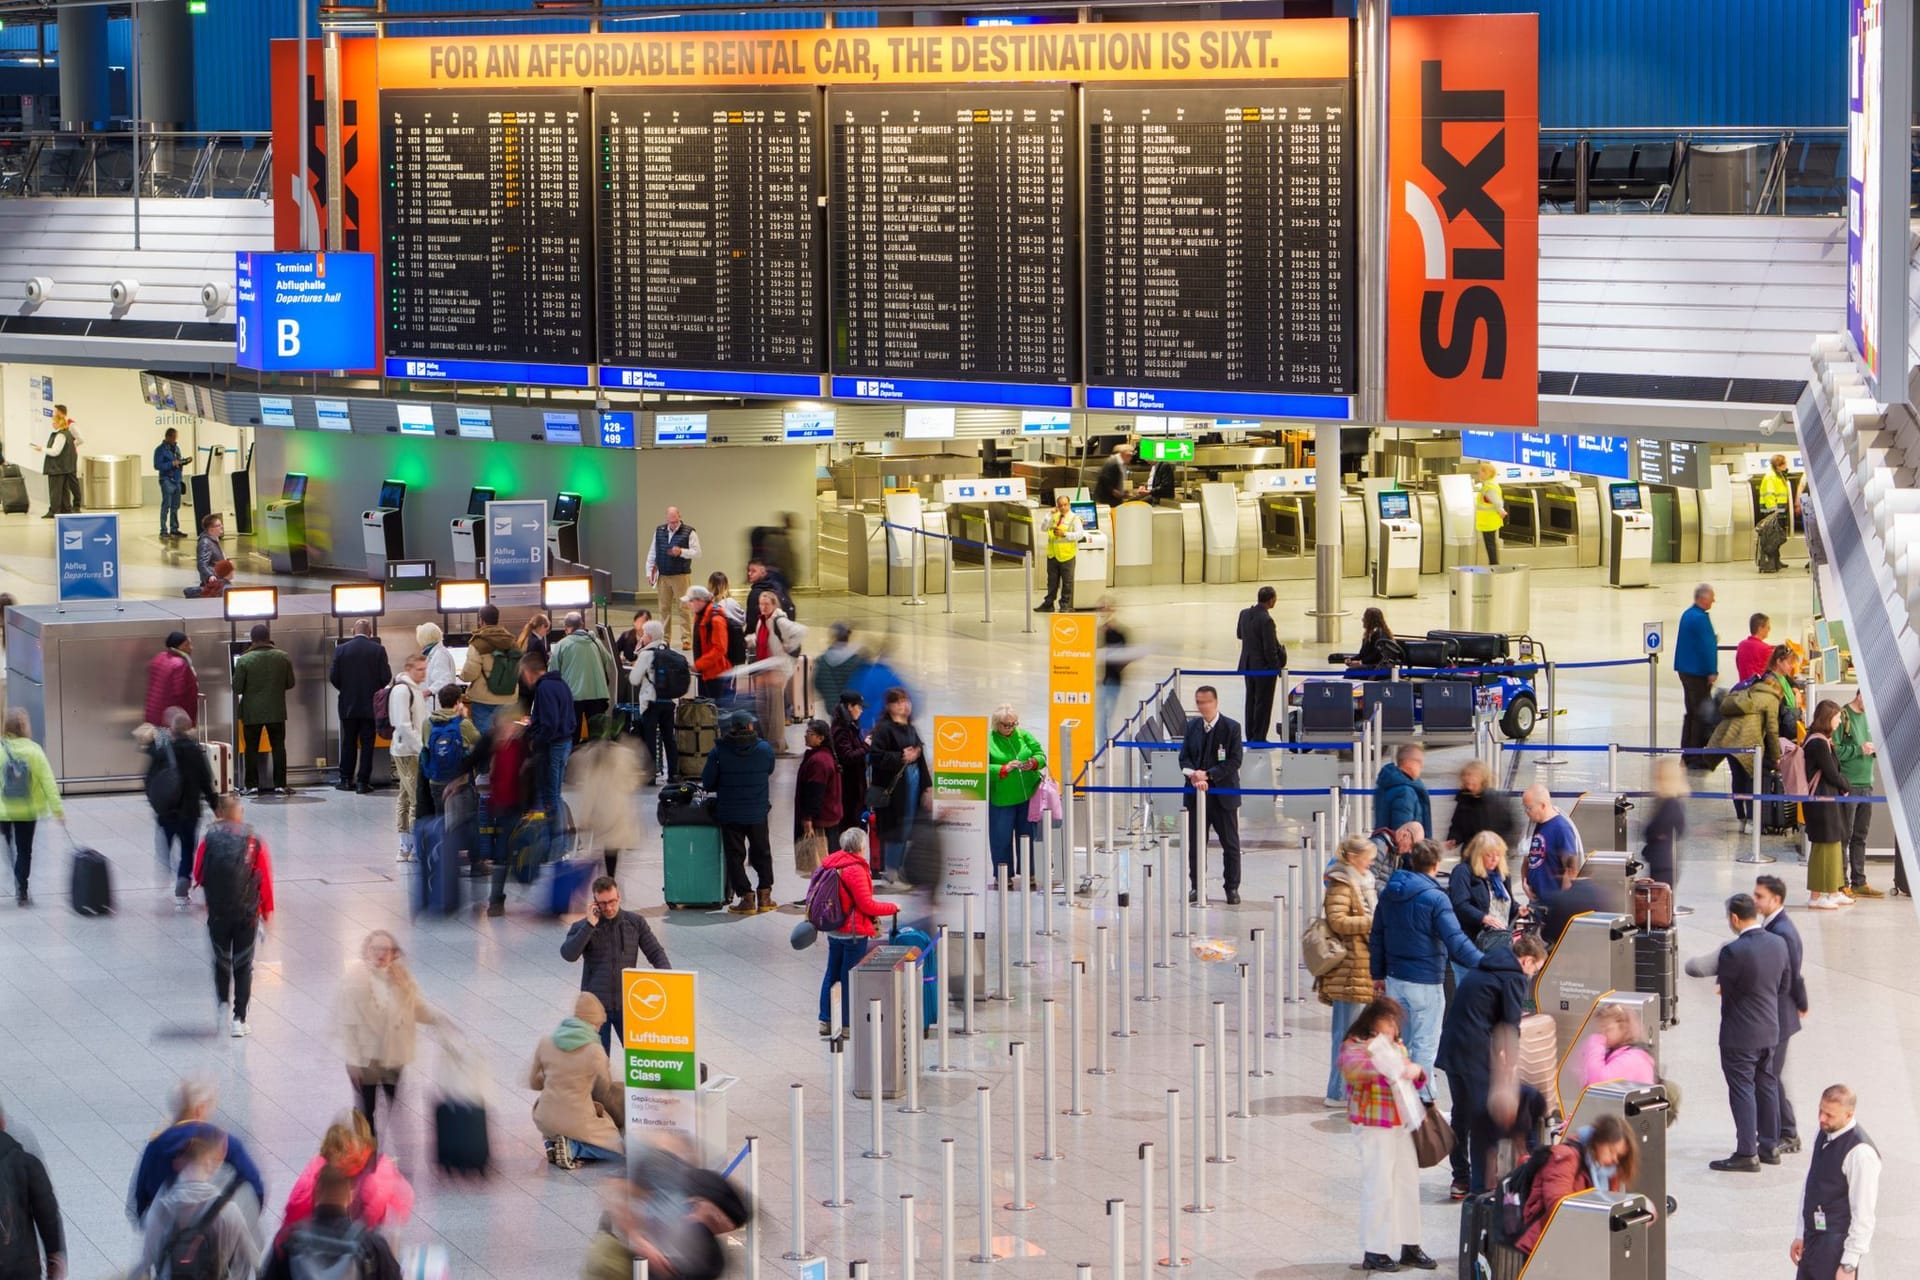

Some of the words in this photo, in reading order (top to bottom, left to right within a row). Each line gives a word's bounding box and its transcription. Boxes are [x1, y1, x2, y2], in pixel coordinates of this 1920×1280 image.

[430, 45, 478, 79] FOR
[485, 44, 519, 79] AN
[526, 40, 695, 78] AFFORDABLE
[703, 39, 806, 76] RENTAL
[813, 37, 880, 81] CAR,
[888, 36, 942, 73] THE
[951, 31, 1151, 72] DESTINATION
[1161, 31, 1190, 70] IS
[1200, 29, 1279, 69] SIXT.
[1405, 60, 1507, 380] SIXT
[275, 263, 313, 273] Terminal
[318, 263, 323, 273] 1
[276, 280, 326, 292] Abflughalle
[276, 293, 322, 304] Departures
[324, 292, 342, 303] hall
[278, 318, 300, 357] B
[604, 434, 620, 444] 499
[531, 546, 541, 563] B
[103, 561, 114, 578] B
[938, 759, 983, 769] Lufthansa
[938, 776, 978, 788] Economy
[938, 786, 961, 794] Class
[630, 1030, 688, 1045] Lufthansa
[630, 1056, 684, 1072] Economy
[630, 1069, 661, 1082] Class
